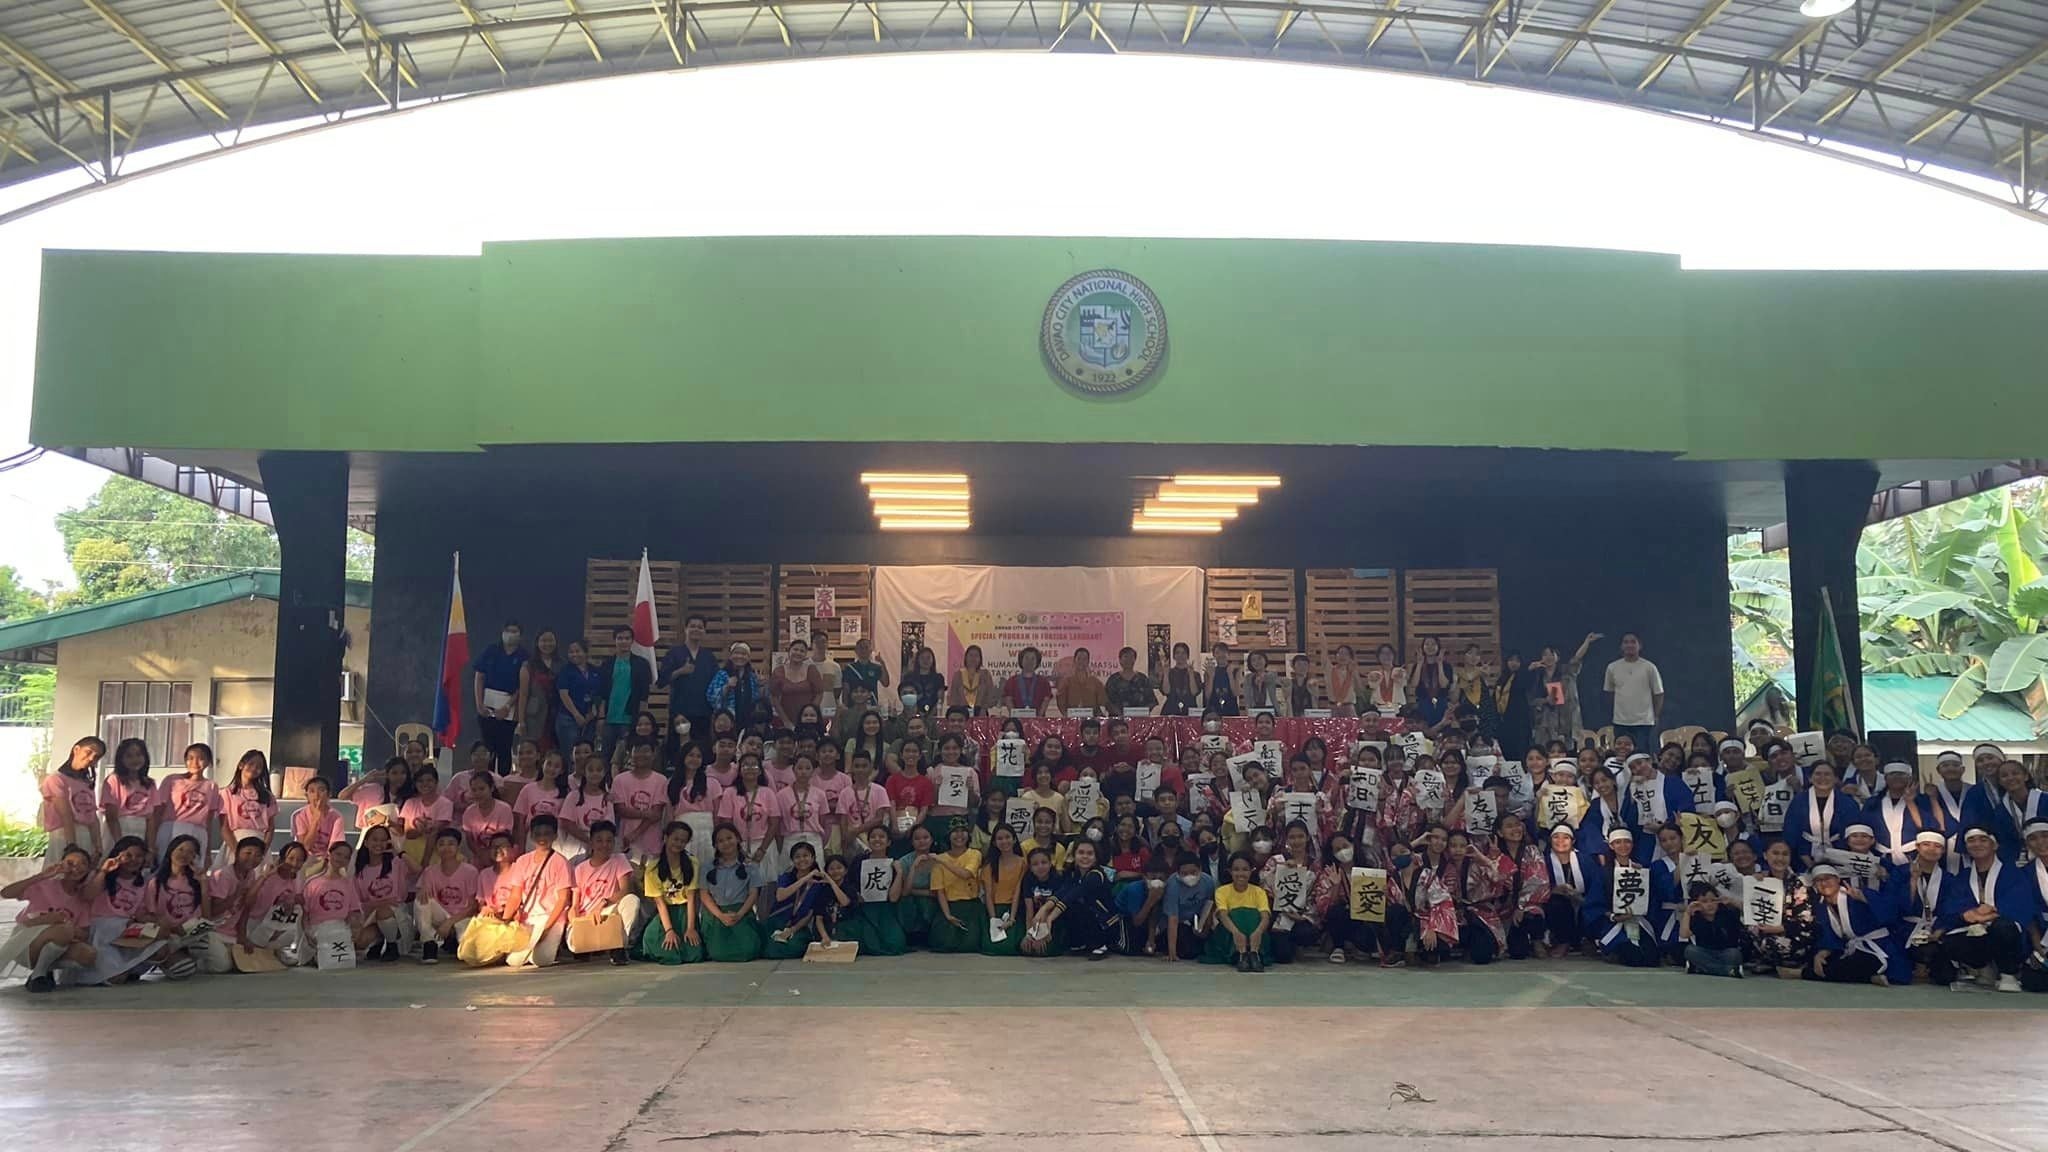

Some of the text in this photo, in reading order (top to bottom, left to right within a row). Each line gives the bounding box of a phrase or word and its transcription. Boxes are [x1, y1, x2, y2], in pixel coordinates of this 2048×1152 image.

[1052, 279, 1159, 362] DAVAO CITY NATIONAL HIGH SCHOOL
[1093, 373, 1116, 383] 1922
[971, 632, 996, 640] SPECIAL
[998, 632, 1030, 640] PROGRAM
[1032, 632, 1039, 640] IN
[1001, 743, 1018, 766] 花
[1690, 777, 1712, 804] 左
[865, 866, 888, 891] 虎
[1616, 870, 1645, 909] 夢
[1277, 872, 1304, 913] 愛
[1357, 881, 1385, 916] 愛
